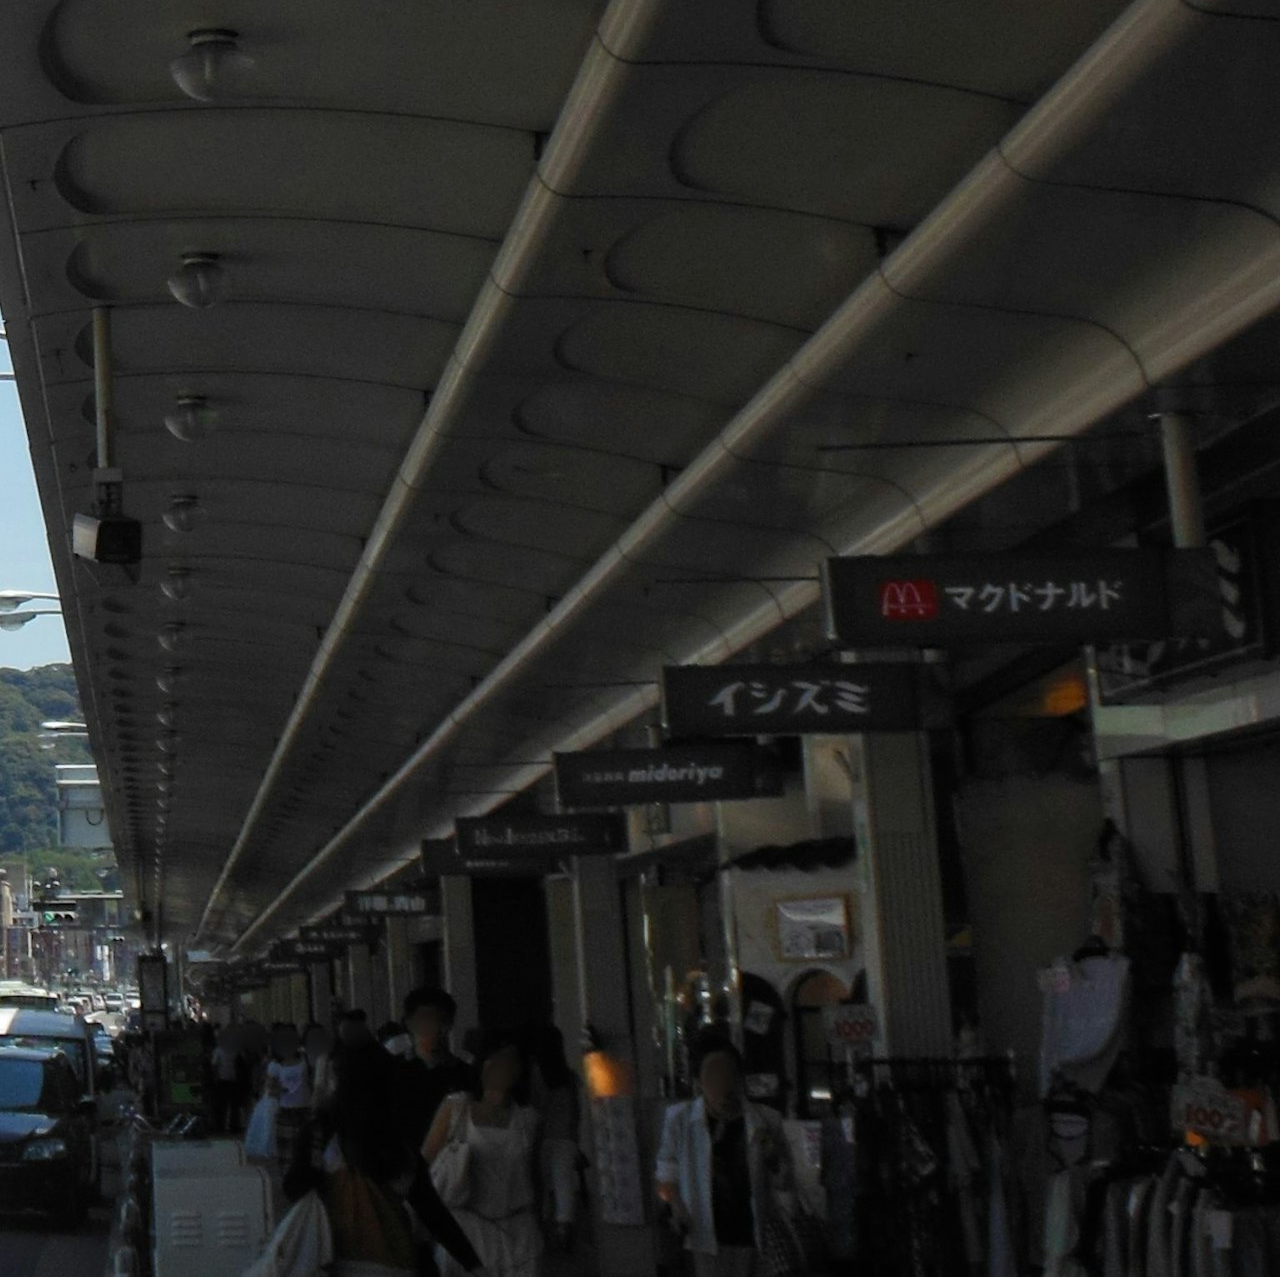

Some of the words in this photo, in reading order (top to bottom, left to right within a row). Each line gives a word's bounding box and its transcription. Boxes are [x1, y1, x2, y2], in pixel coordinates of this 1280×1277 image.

[944, 579, 1124, 613] マクドナルド
[708, 679, 870, 717] イシズミ
[628, 762, 725, 785] midoriya
